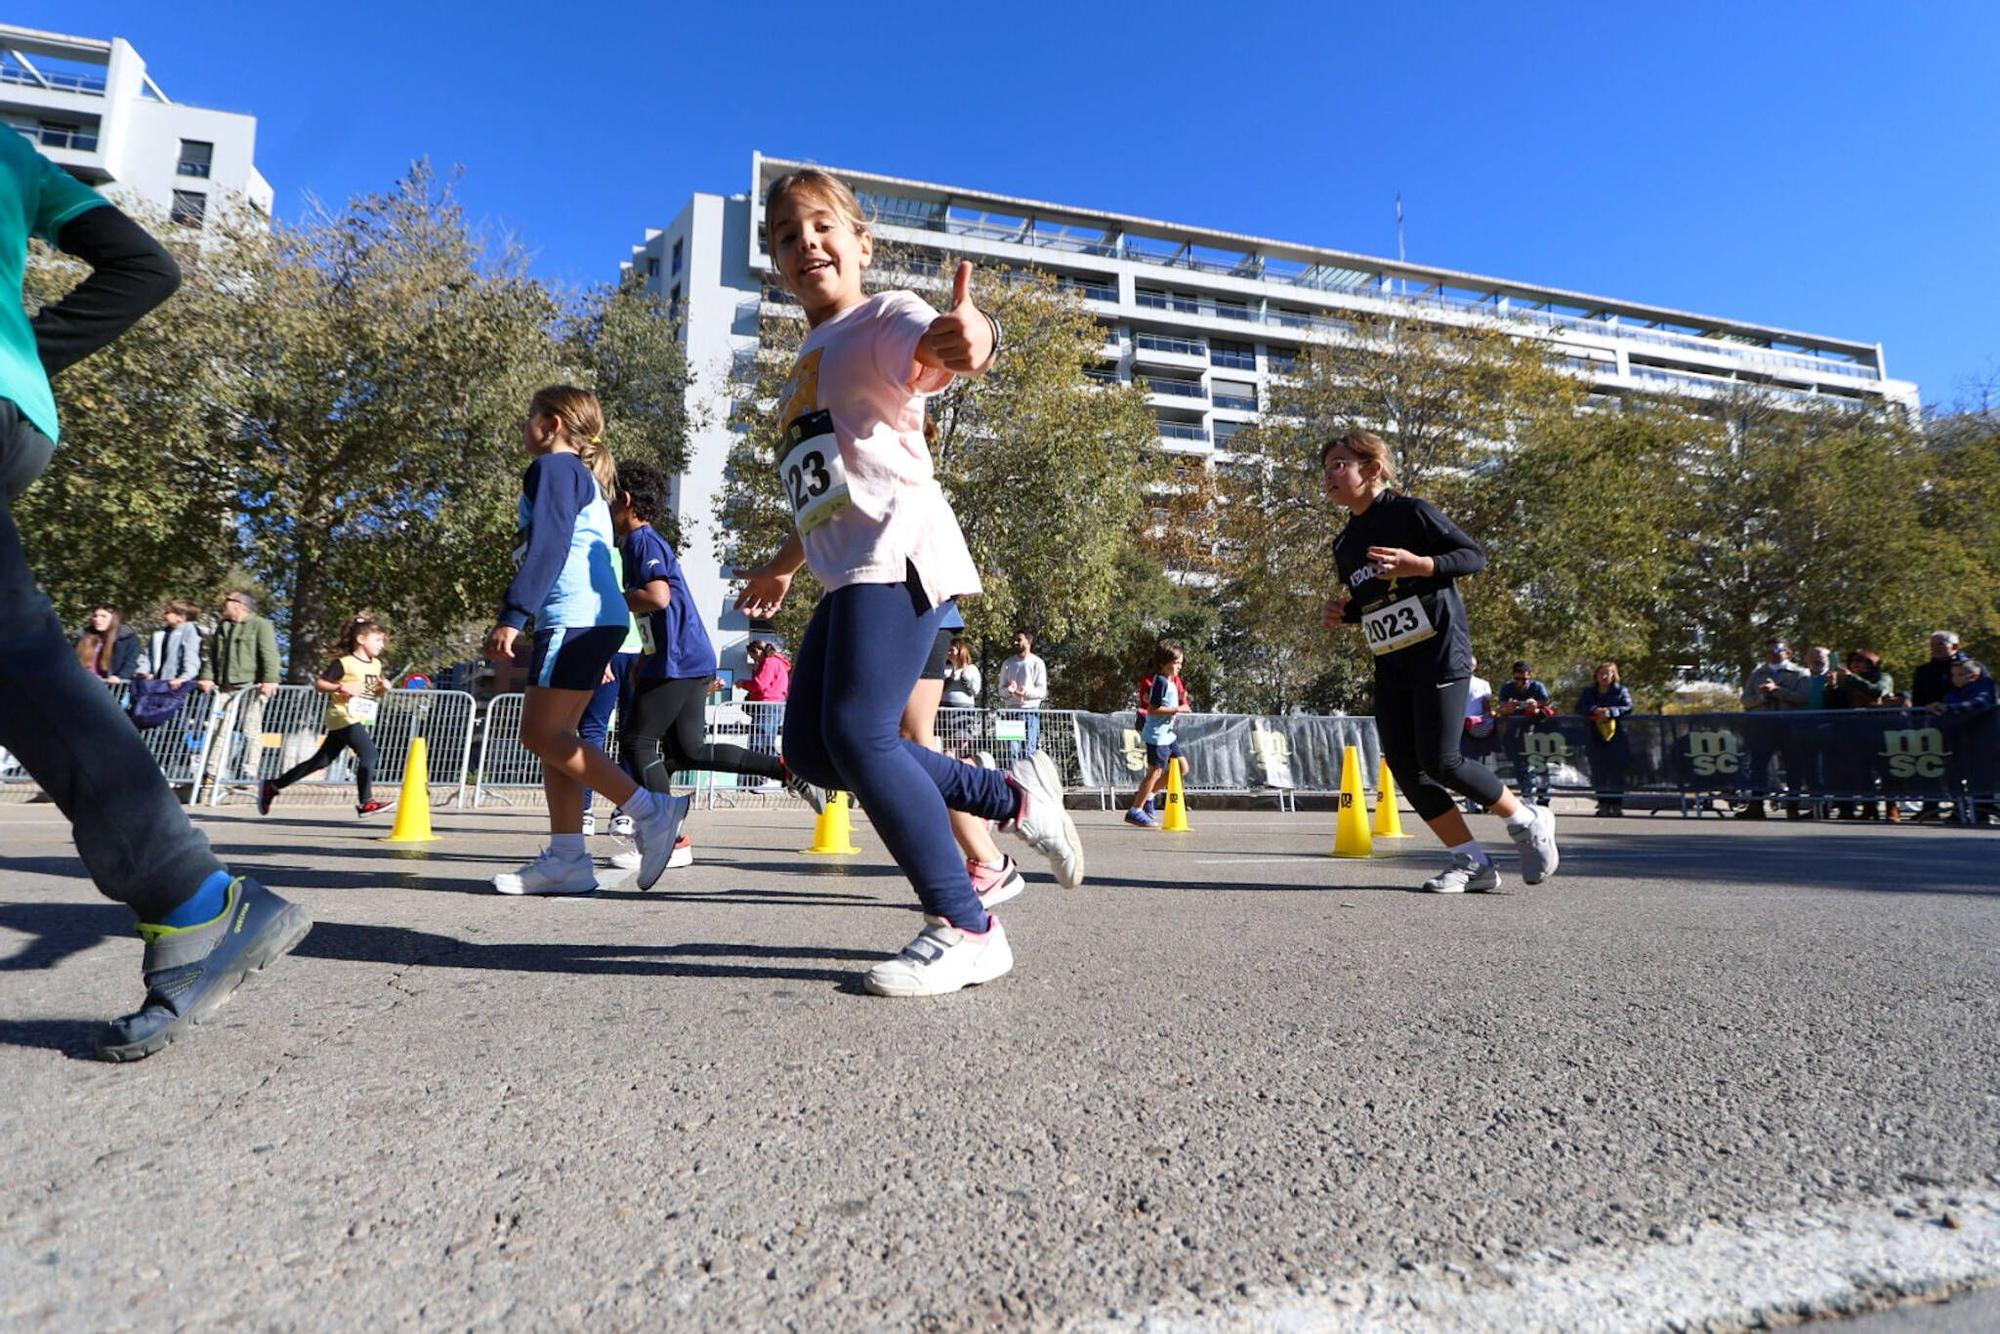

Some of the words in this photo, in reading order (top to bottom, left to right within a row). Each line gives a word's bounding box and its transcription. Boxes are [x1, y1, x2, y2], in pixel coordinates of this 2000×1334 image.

[784, 450, 831, 518] 23
[1364, 607, 1419, 644] 2023
[1126, 752, 1149, 771] s
